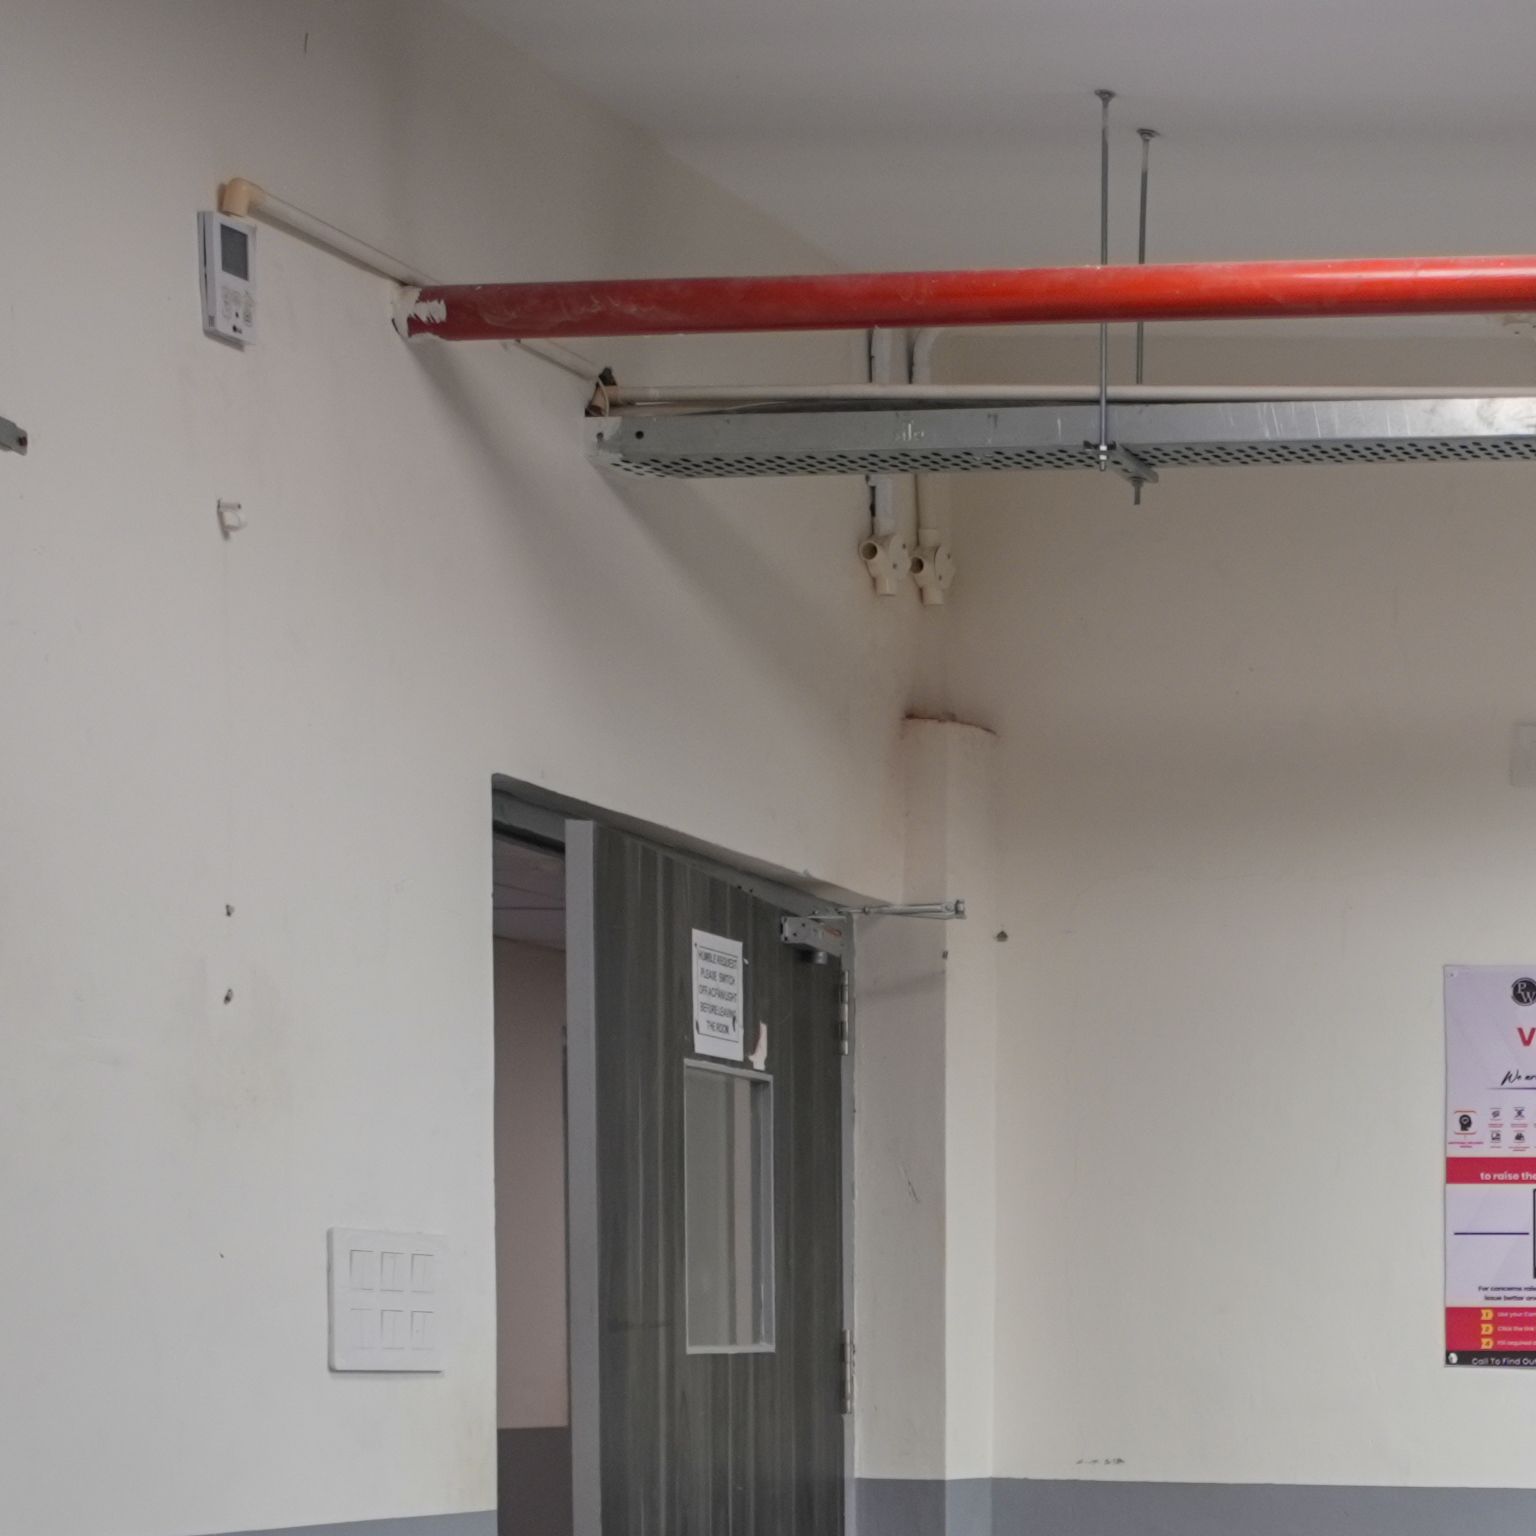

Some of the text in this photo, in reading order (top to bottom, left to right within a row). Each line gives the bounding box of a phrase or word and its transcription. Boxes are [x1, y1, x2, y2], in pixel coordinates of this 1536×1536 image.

[1480, 1172, 1491, 1180] to
[1493, 1172, 1520, 1180] raise
[1472, 1358, 1489, 1366] Call
[1491, 1358, 1501, 1366] To
[1502, 1358, 1521, 1366] Find
